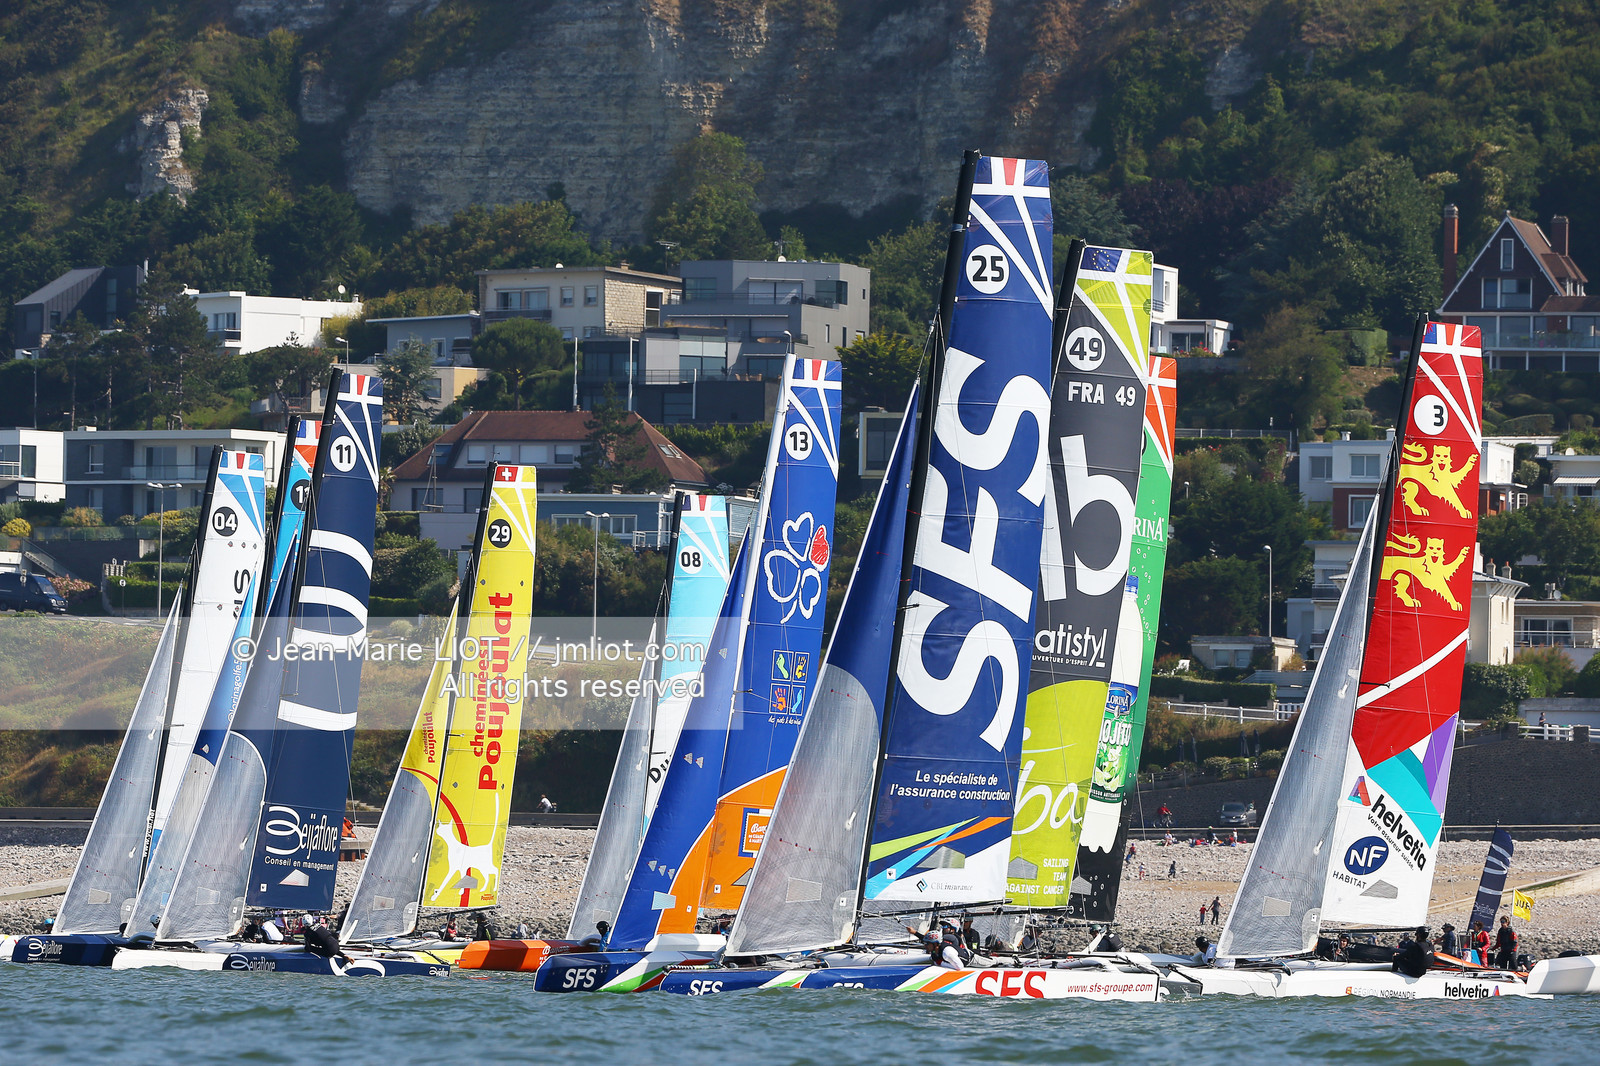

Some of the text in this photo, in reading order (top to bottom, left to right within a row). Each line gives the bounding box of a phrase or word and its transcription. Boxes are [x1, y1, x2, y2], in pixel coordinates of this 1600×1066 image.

[971, 254, 1005, 282] 25
[1069, 337, 1102, 362] 49
[1068, 381, 1136, 407] FRA 49
[1432, 404, 1444, 427] 3
[789, 431, 809, 451] 13
[335, 444, 352, 463] 11
[212, 513, 237, 531] 04
[490, 524, 512, 543] 29
[896, 346, 1052, 753] SFS
[680, 551, 702, 568] 08
[478, 592, 513, 790] Poujoulat
[915, 770, 998, 786] Le spécialiste de
[890, 783, 1011, 801] l'assurance construction
[1367, 813, 1382, 831] Votre
[1381, 830, 1401, 852] assureur
[1371, 794, 1426, 871] helvetia
[264, 855, 334, 871] Conseil en management
[1043, 858, 1069, 868] SAILING
[1348, 845, 1387, 868] NF
[1053, 871, 1067, 882] TEAM
[1332, 870, 1367, 889] HABITAT
[1005, 883, 1064, 895] AGAINST CANCER
[562, 968, 597, 989] SFS
[687, 979, 723, 996] SFS
[975, 970, 1047, 999] SFS
[1067, 982, 1153, 995] www.sfs-groupe.com
[1379, 989, 1417, 999] NORMANDIE
[1444, 982, 1489, 999] helvetia
